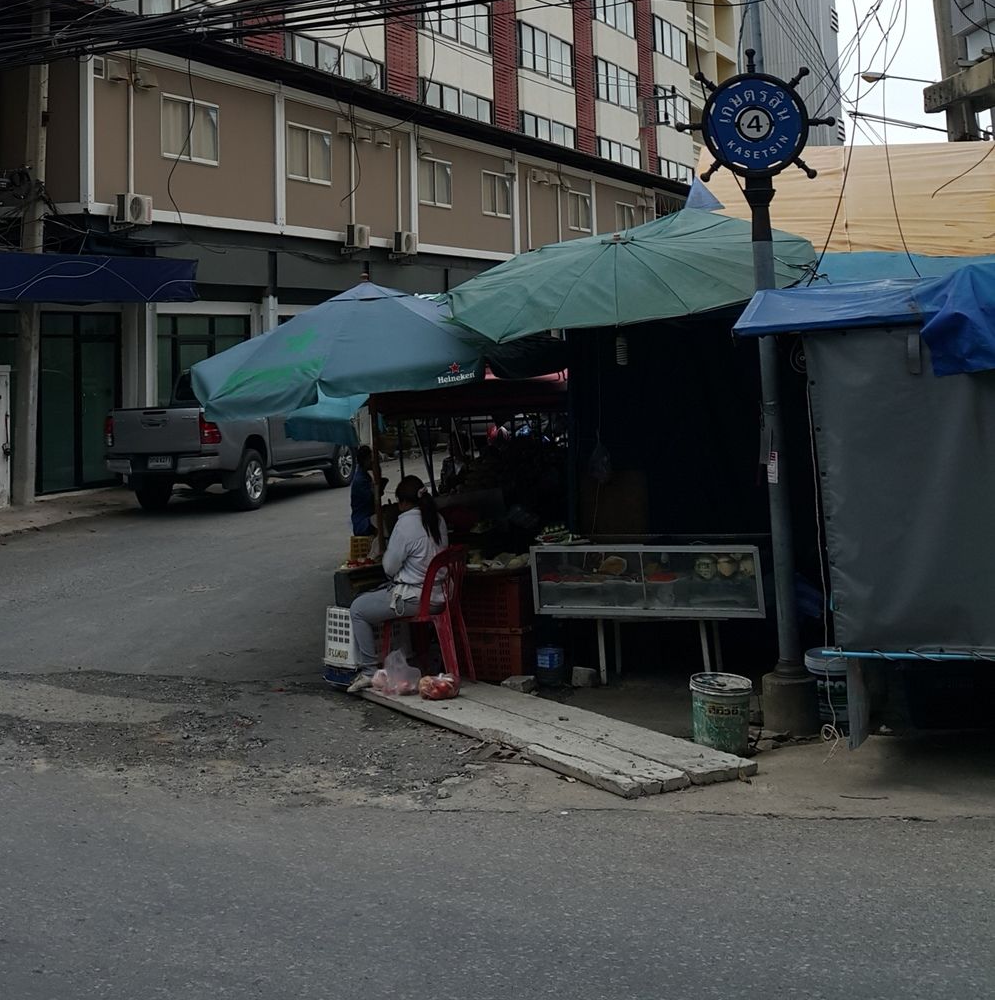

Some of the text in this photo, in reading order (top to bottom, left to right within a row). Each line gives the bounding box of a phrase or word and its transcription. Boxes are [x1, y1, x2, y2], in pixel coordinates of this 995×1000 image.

[747, 115, 763, 133] 4
[727, 135, 789, 160] KASETSIN
[437, 371, 476, 384] Heineken
